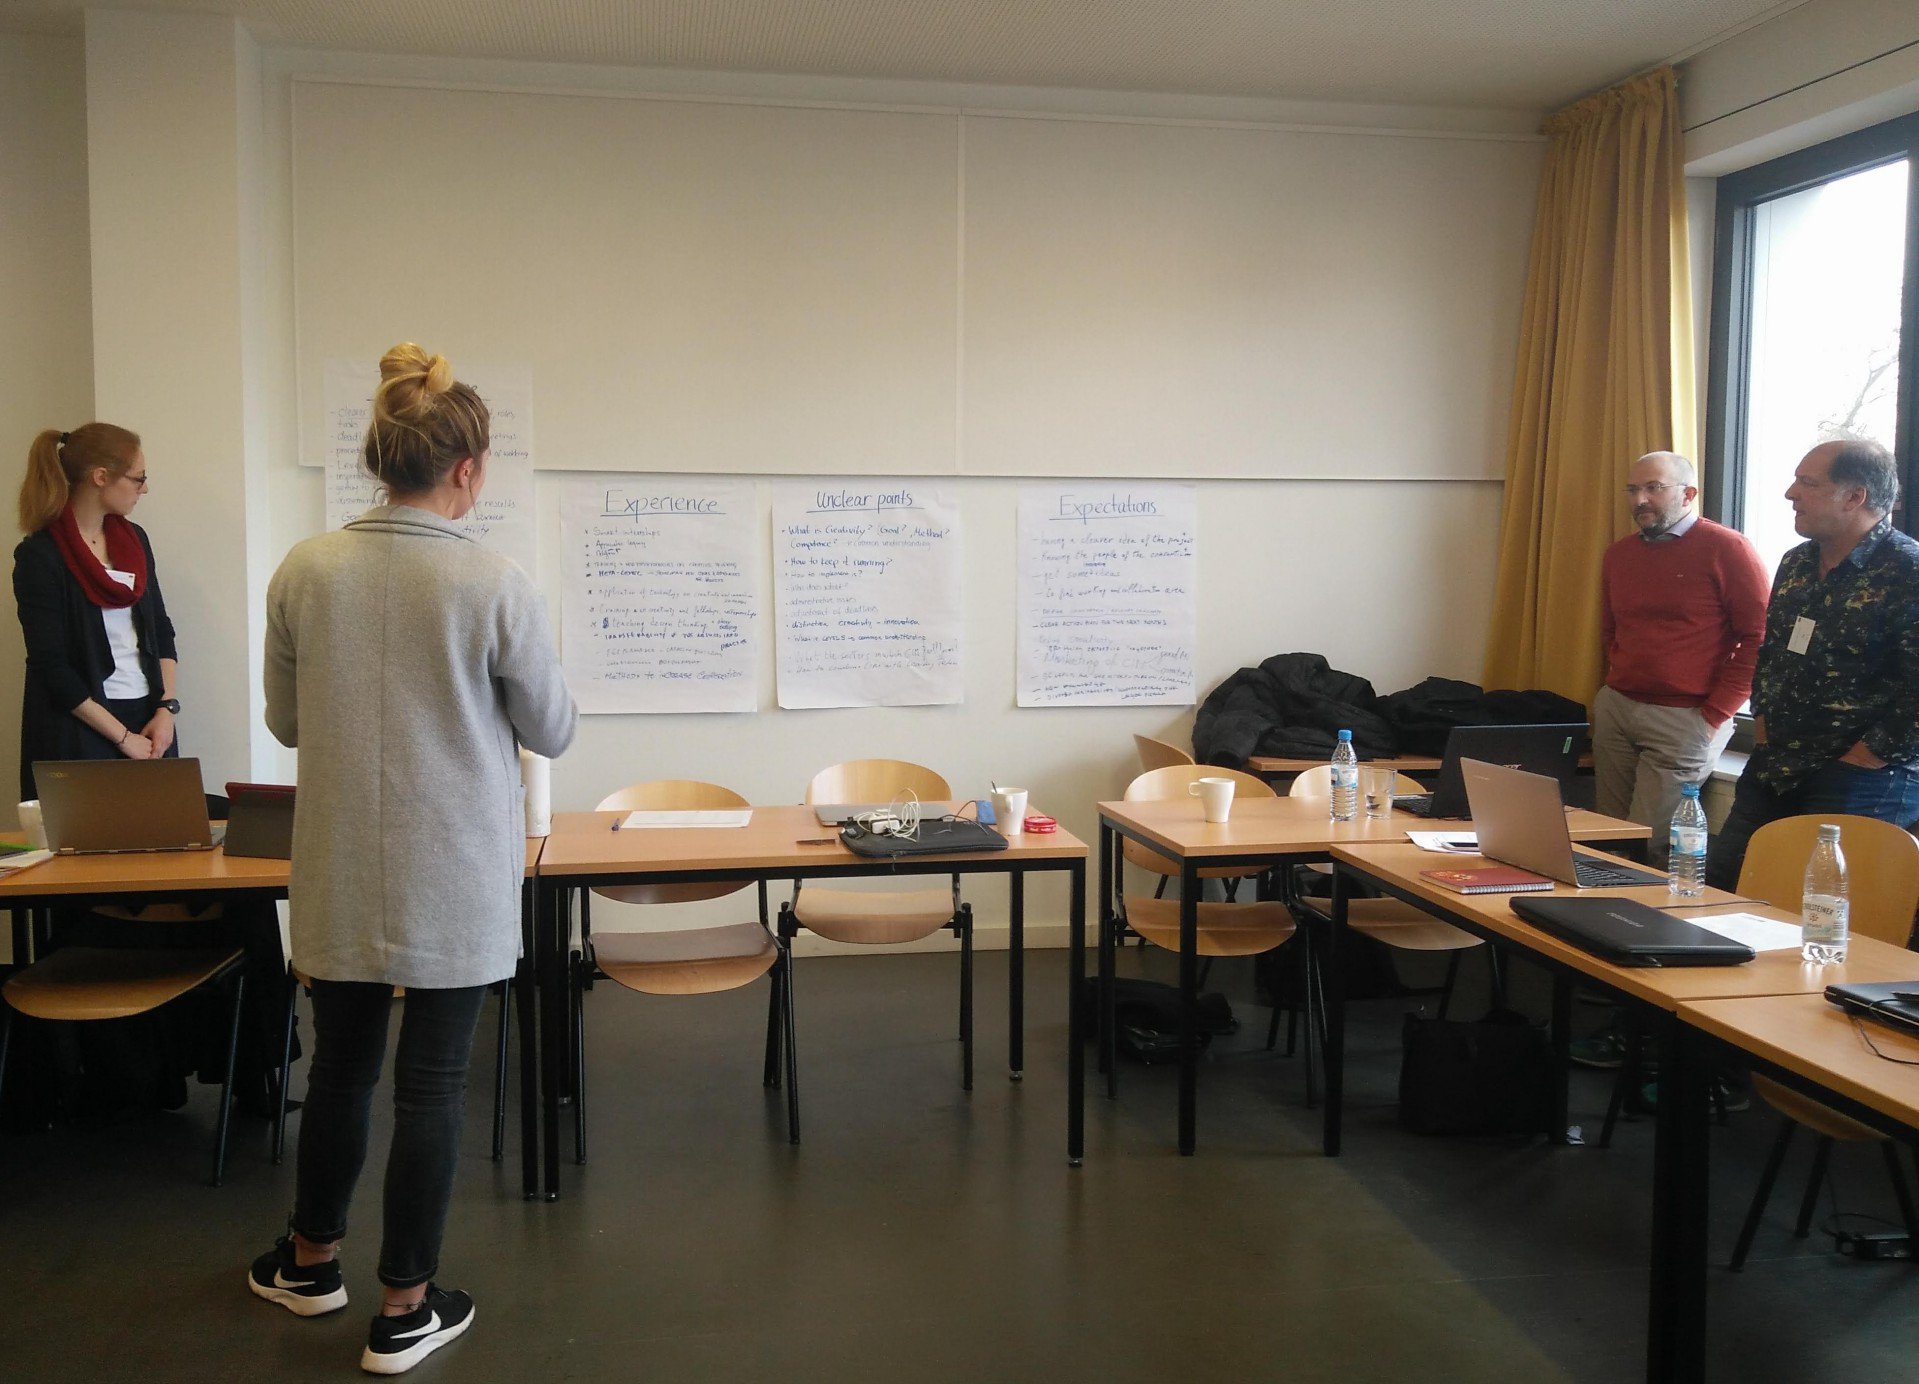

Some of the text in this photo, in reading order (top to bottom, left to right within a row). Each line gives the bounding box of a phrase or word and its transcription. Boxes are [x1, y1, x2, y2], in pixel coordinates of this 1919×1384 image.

[605, 489, 718, 523] Experience
[816, 489, 913, 513] Unclear points
[1060, 493, 1157, 525] Expectations
[788, 525, 810, 535] What
[790, 557, 806, 565] How
